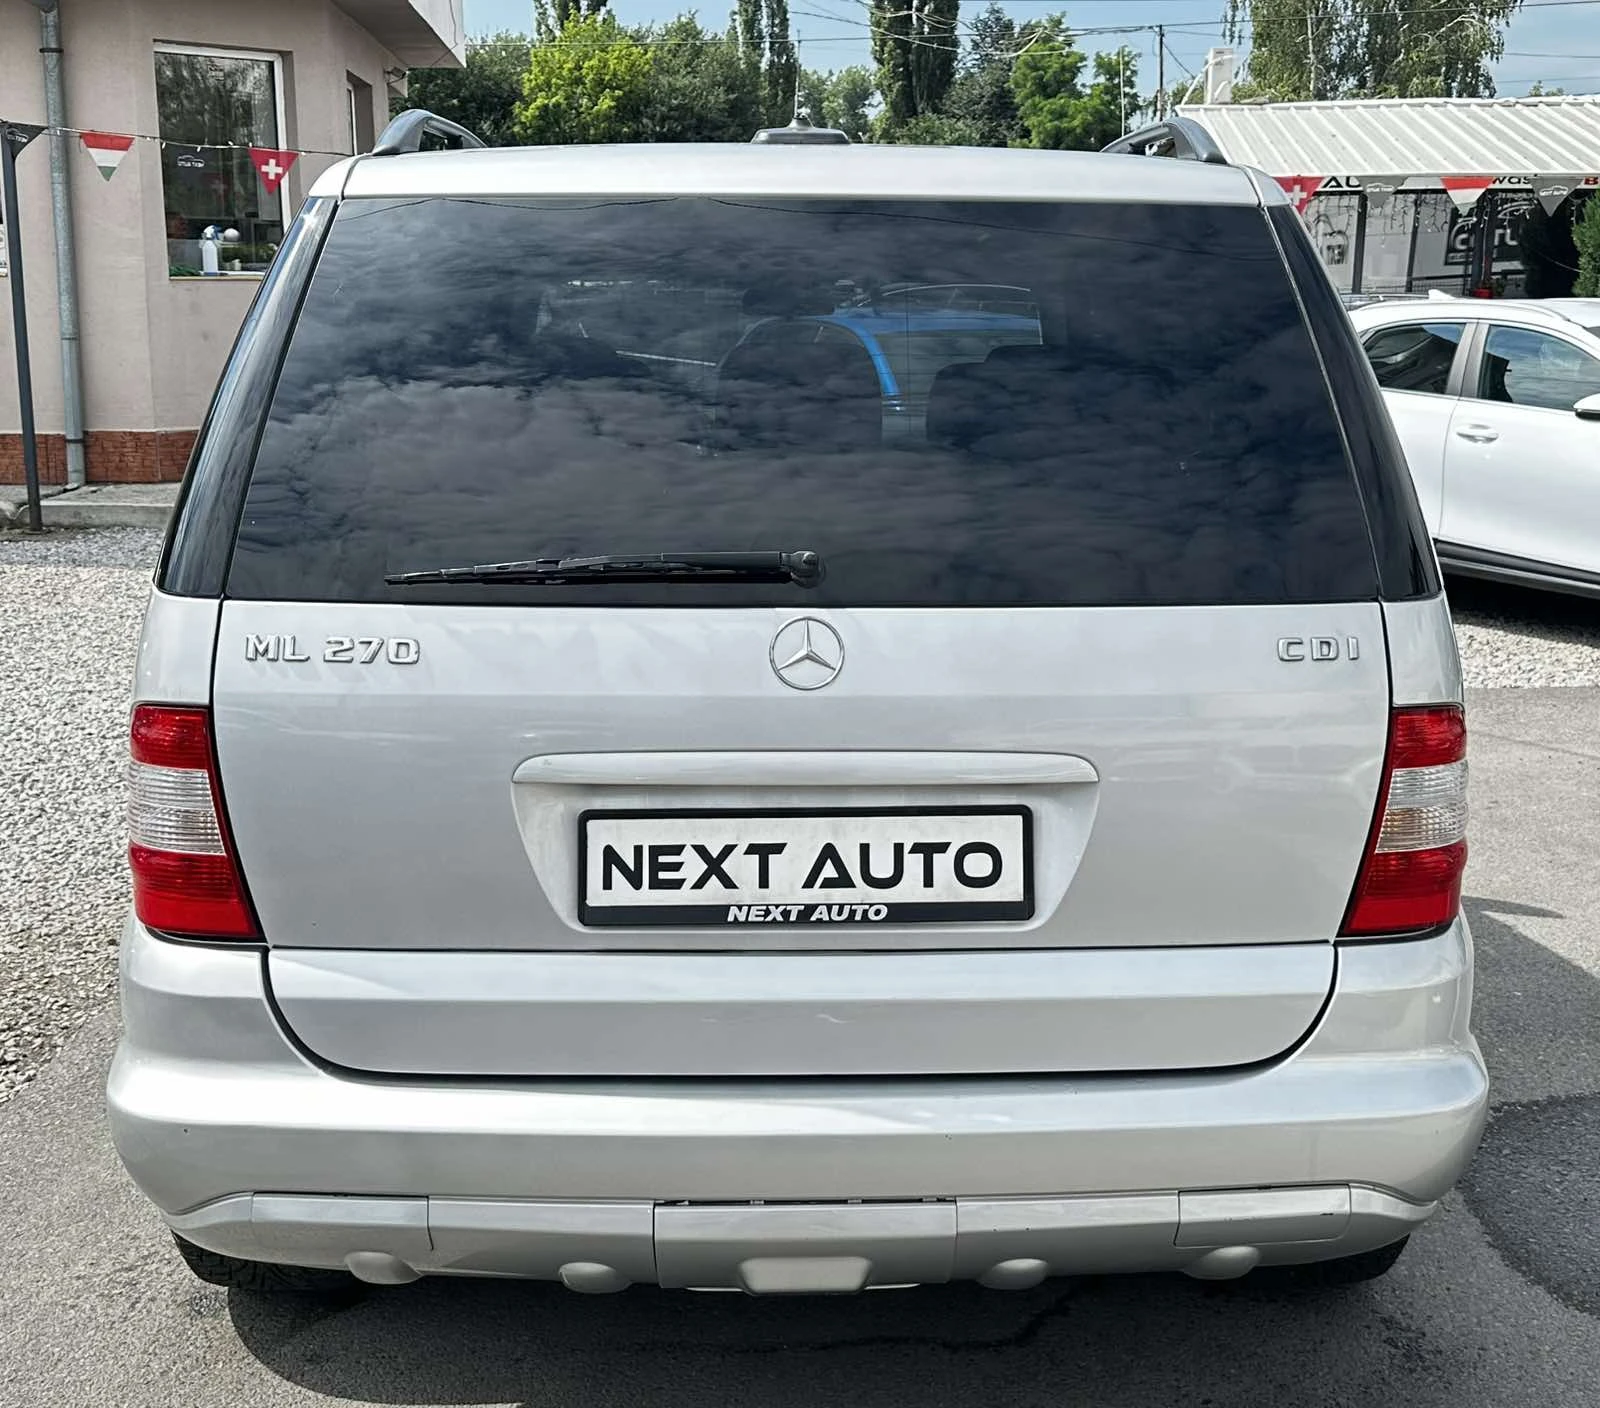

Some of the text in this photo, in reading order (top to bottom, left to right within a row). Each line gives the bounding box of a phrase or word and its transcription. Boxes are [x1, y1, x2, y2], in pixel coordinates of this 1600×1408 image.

[246, 635, 421, 665] ML 270
[1277, 636, 1360, 662] CDI
[603, 842, 1002, 890] NEXT AUTO
[727, 904, 889, 923] NEXT AUTO
